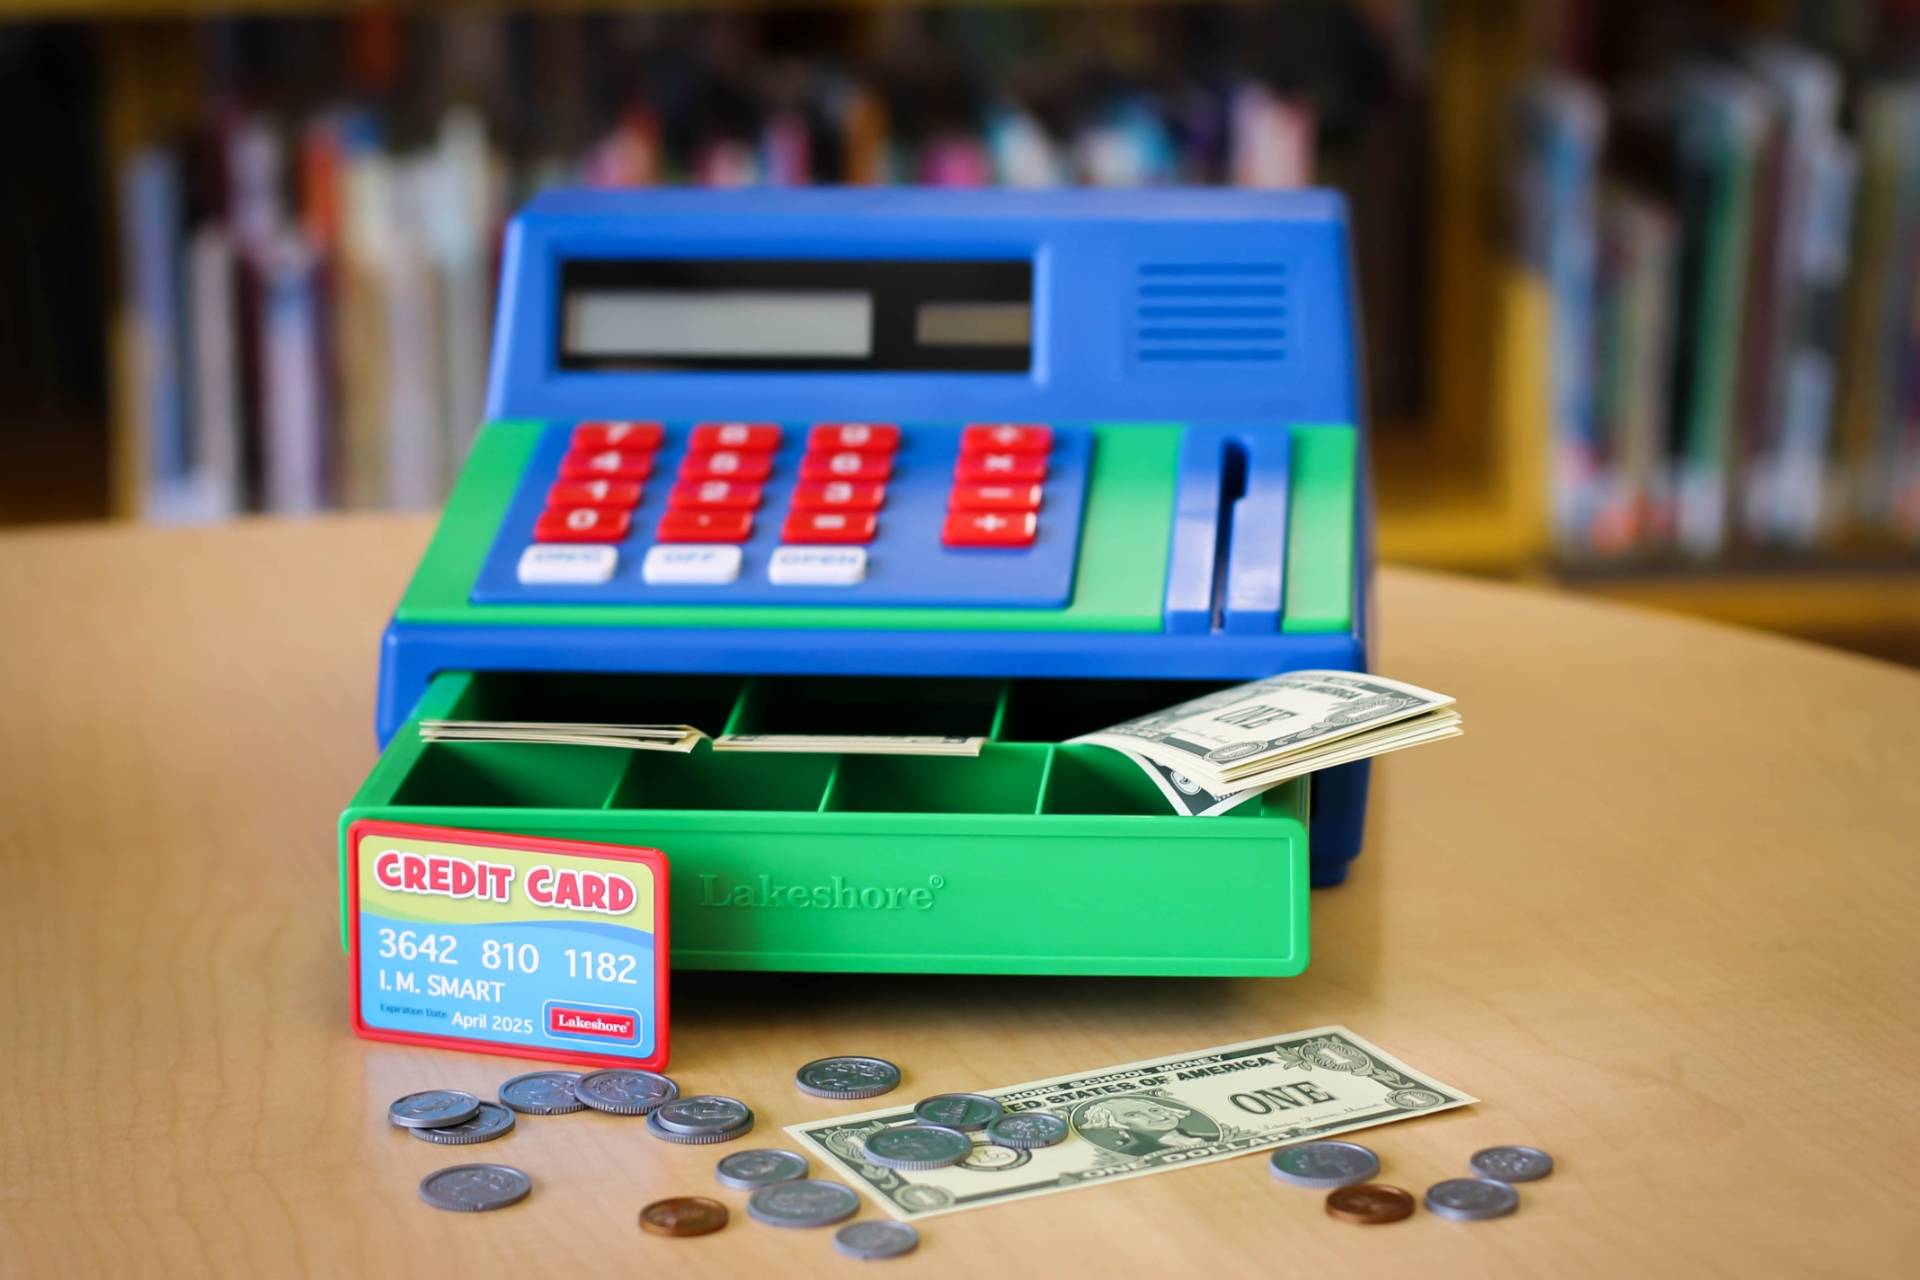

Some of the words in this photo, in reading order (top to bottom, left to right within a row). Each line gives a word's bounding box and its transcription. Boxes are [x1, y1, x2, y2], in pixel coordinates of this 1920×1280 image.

[606, 421, 634, 445] 7
[588, 450, 622, 474] 4
[698, 479, 731, 503] 2
[1213, 704, 1297, 730] ONE
[375, 851, 514, 901] CREDIT
[525, 867, 636, 913] CARD
[378, 928, 459, 965] 3642
[481, 939, 540, 974] 810
[564, 949, 637, 985] 1182
[426, 974, 506, 1003] SMART
[379, 1003, 424, 1017] Expiration
[425, 1008, 448, 1018] Date
[451, 1011, 488, 1029] April
[491, 1015, 534, 1035] 2025
[1003, 1100, 1042, 1113] ED
[1045, 1082, 1137, 1104] STATES
[1139, 1074, 1169, 1087] OF
[1176, 1056, 1275, 1081] AMERICA
[1069, 1069, 1152, 1089] SCHOOL
[1156, 1054, 1224, 1073] MONEY
[1228, 1081, 1337, 1115] ONE
[1083, 1161, 1152, 1178] ONE
[1161, 1131, 1291, 1164] DOLLAR
